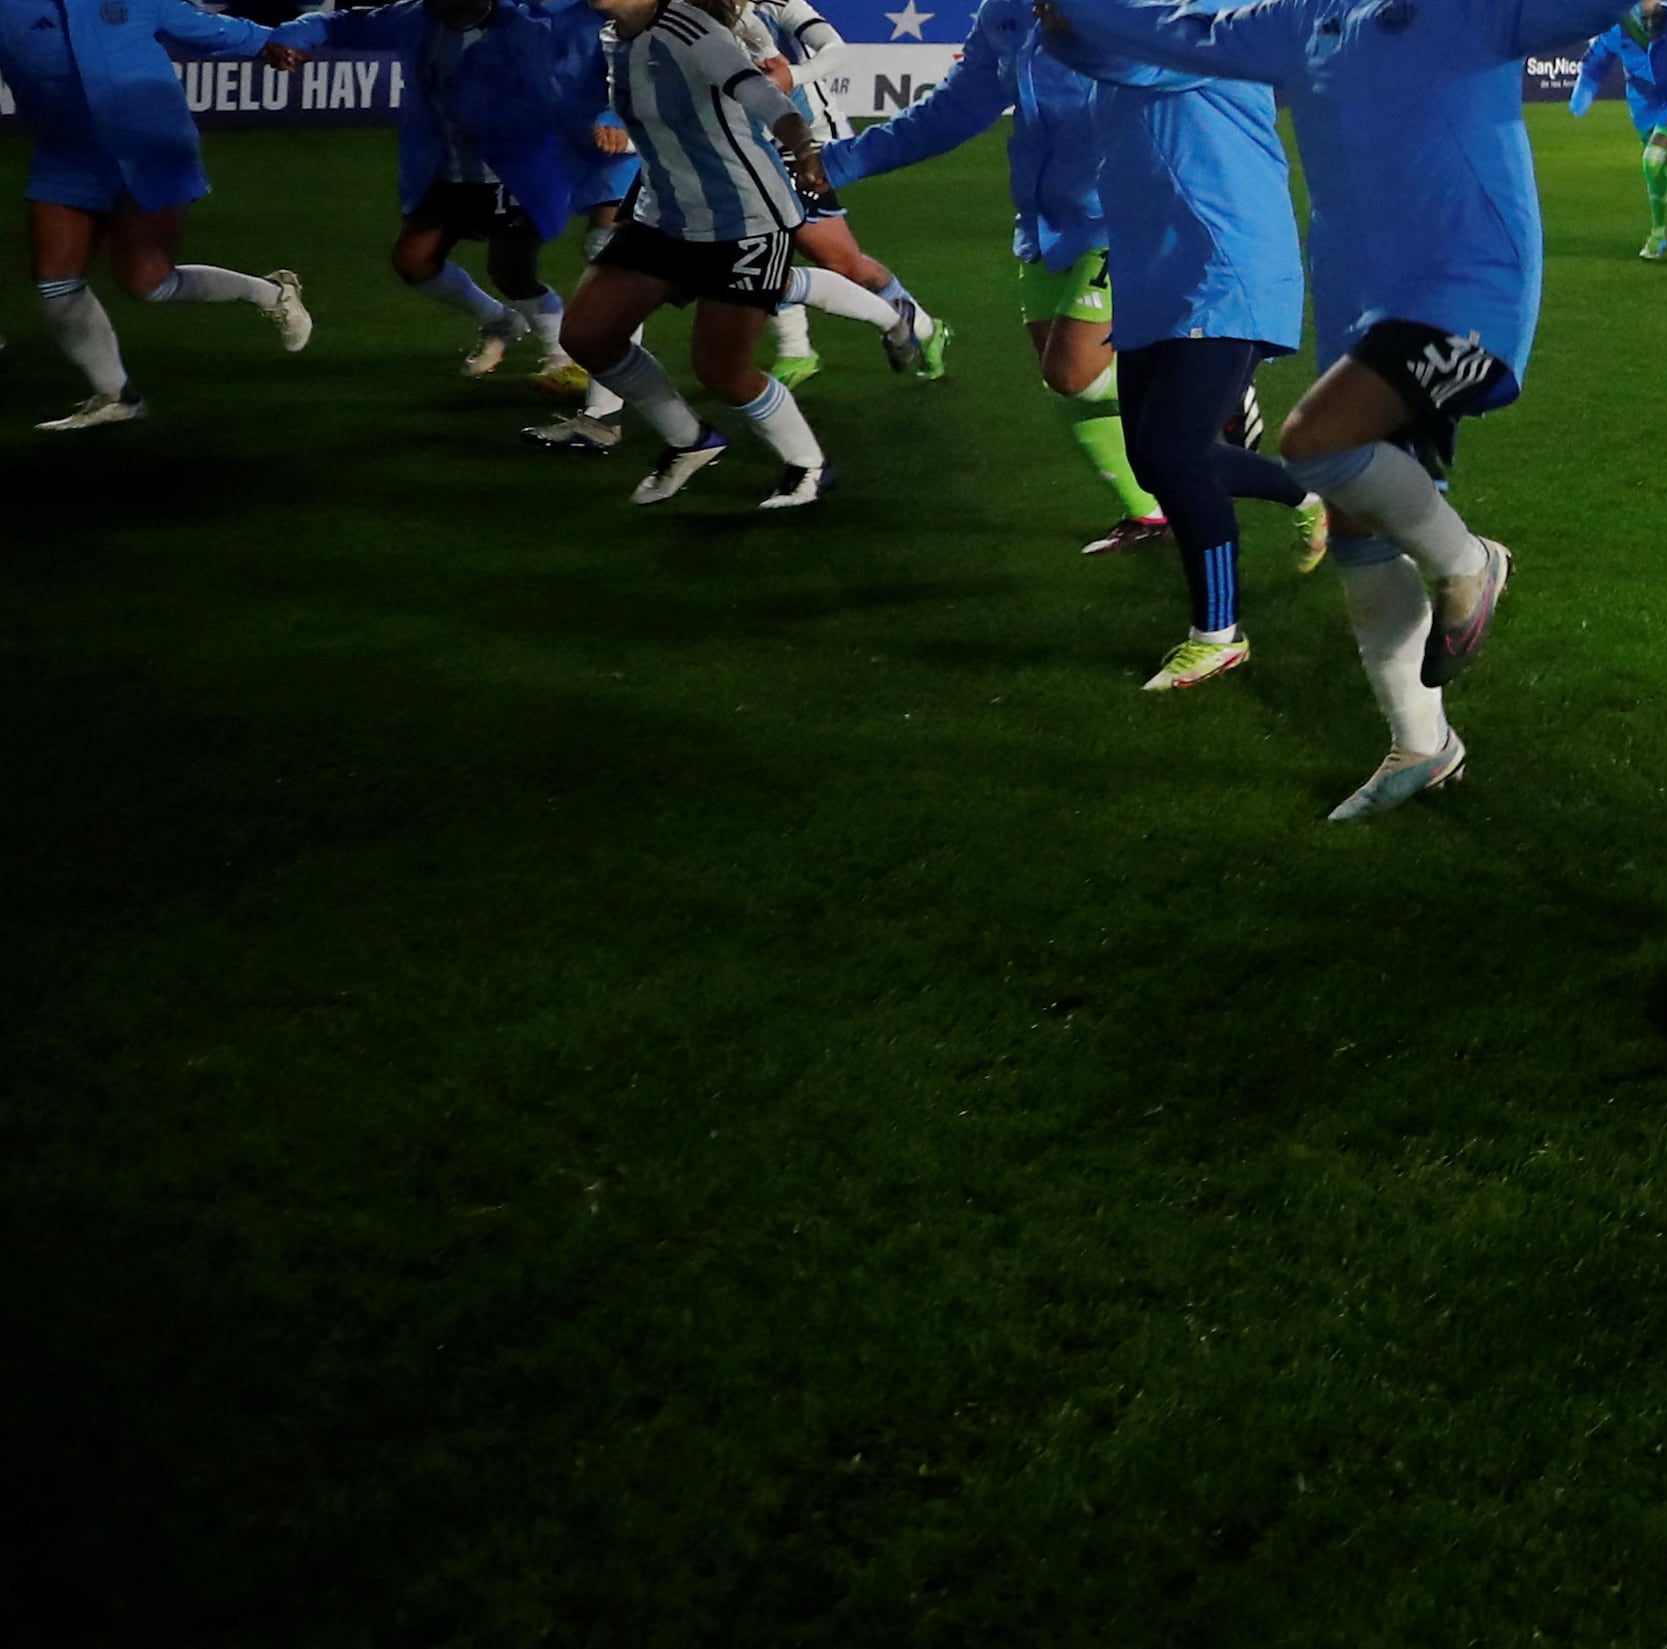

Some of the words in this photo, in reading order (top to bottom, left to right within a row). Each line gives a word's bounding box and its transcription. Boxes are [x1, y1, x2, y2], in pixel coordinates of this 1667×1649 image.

[172, 61, 290, 113] UELO
[302, 60, 379, 110] HAY
[1527, 56, 1556, 80] San
[732, 236, 771, 277] 2
